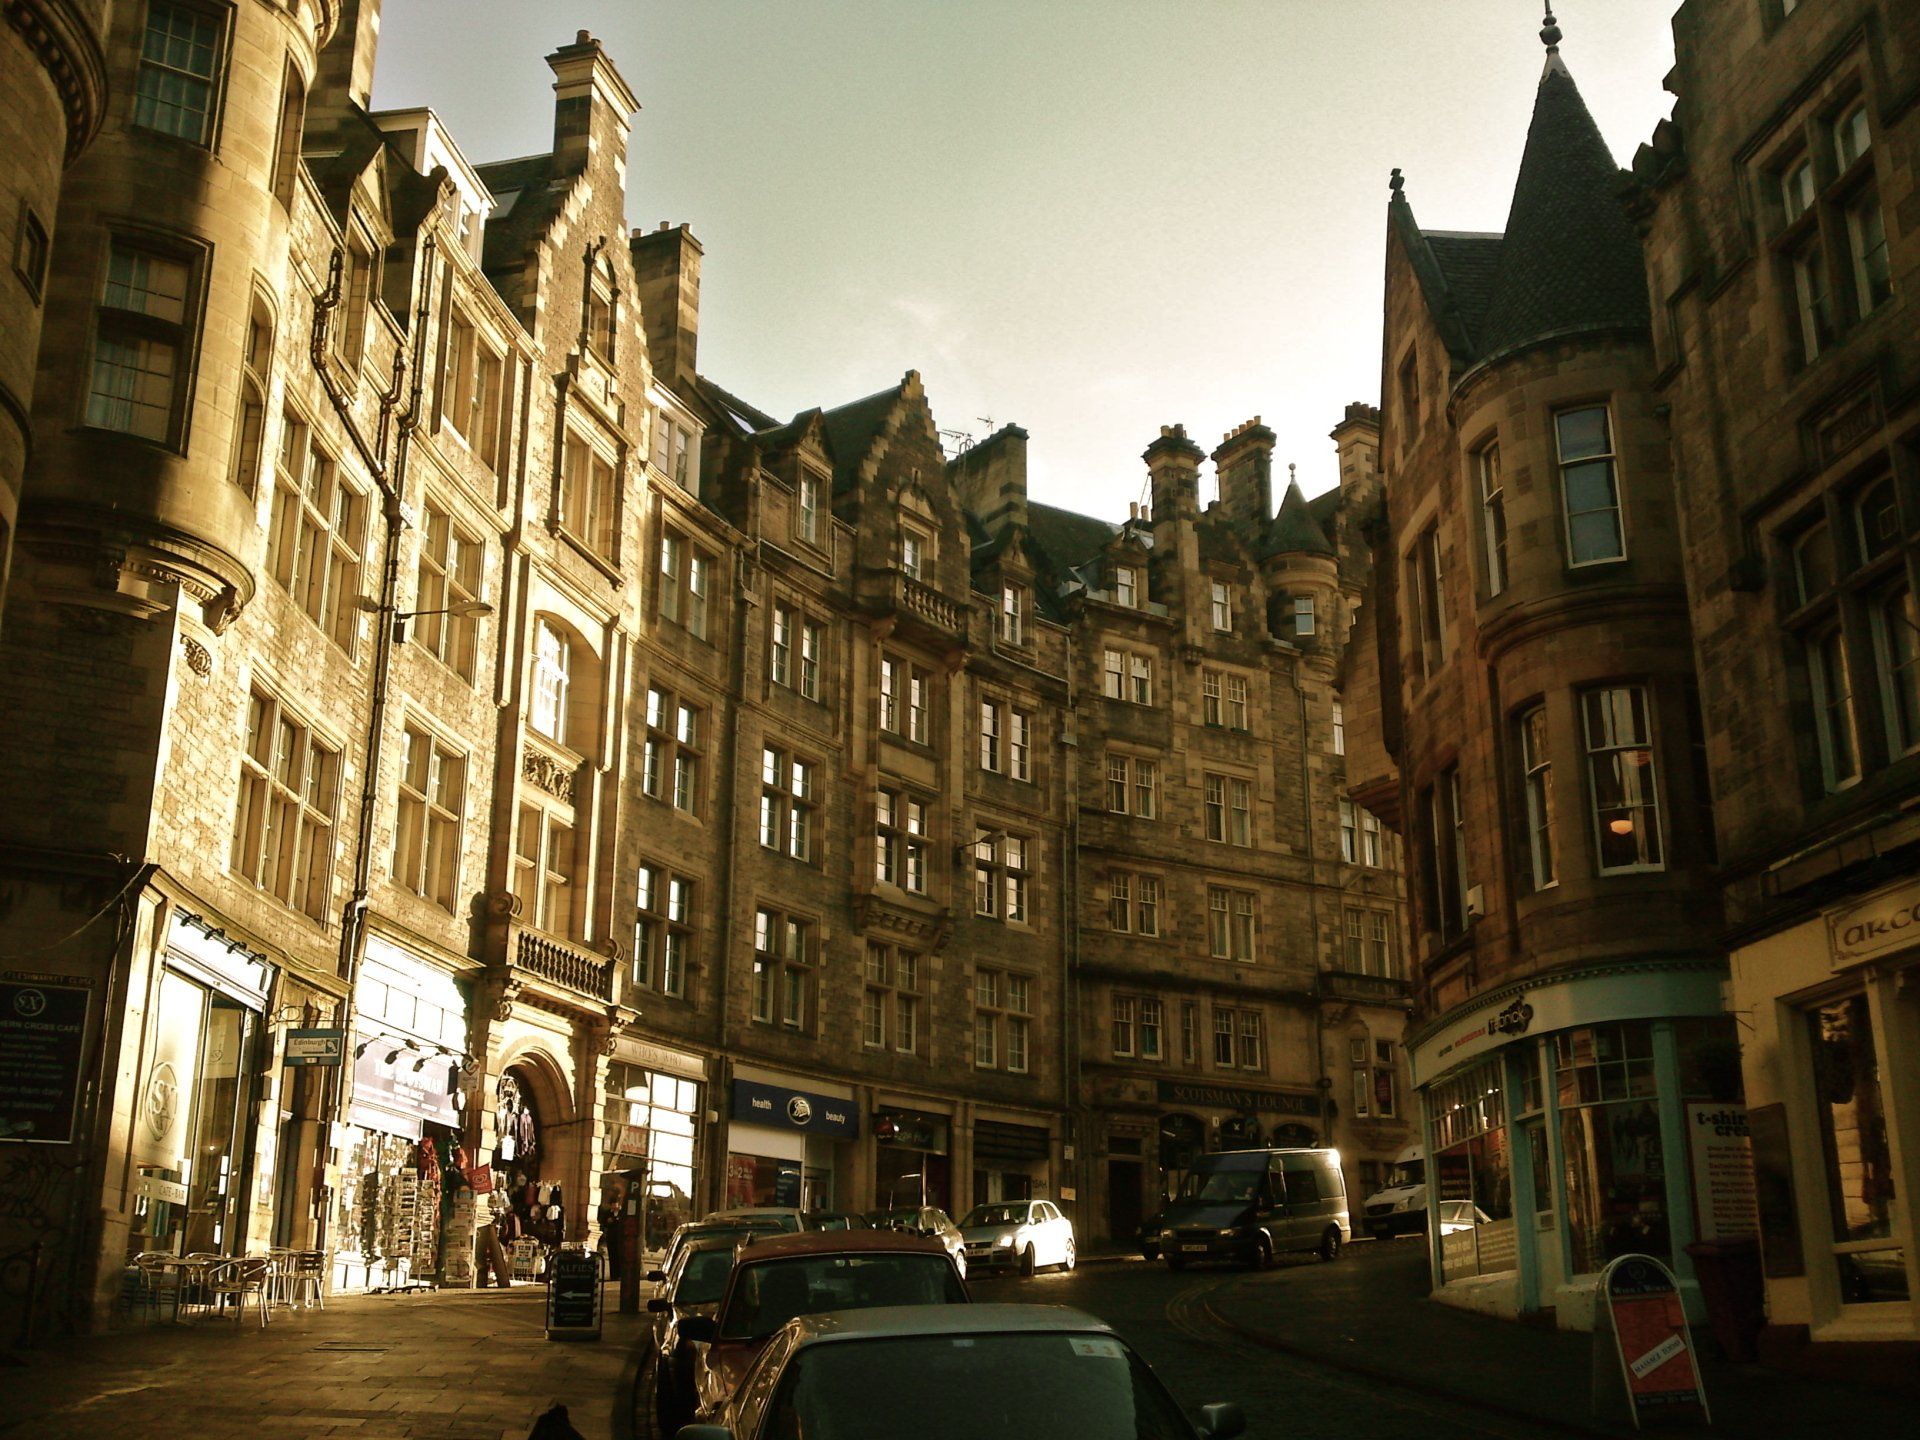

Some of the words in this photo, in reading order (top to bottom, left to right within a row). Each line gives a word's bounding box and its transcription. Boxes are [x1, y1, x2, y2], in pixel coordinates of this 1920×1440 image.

[294, 1038, 326, 1047] Edinburgh
[752, 1098, 773, 1111] health
[1256, 1094, 1306, 1111] LOUNGE
[826, 1110, 847, 1125] beauty
[631, 1181, 641, 1194] P
[560, 1262, 594, 1273] ALFIES
